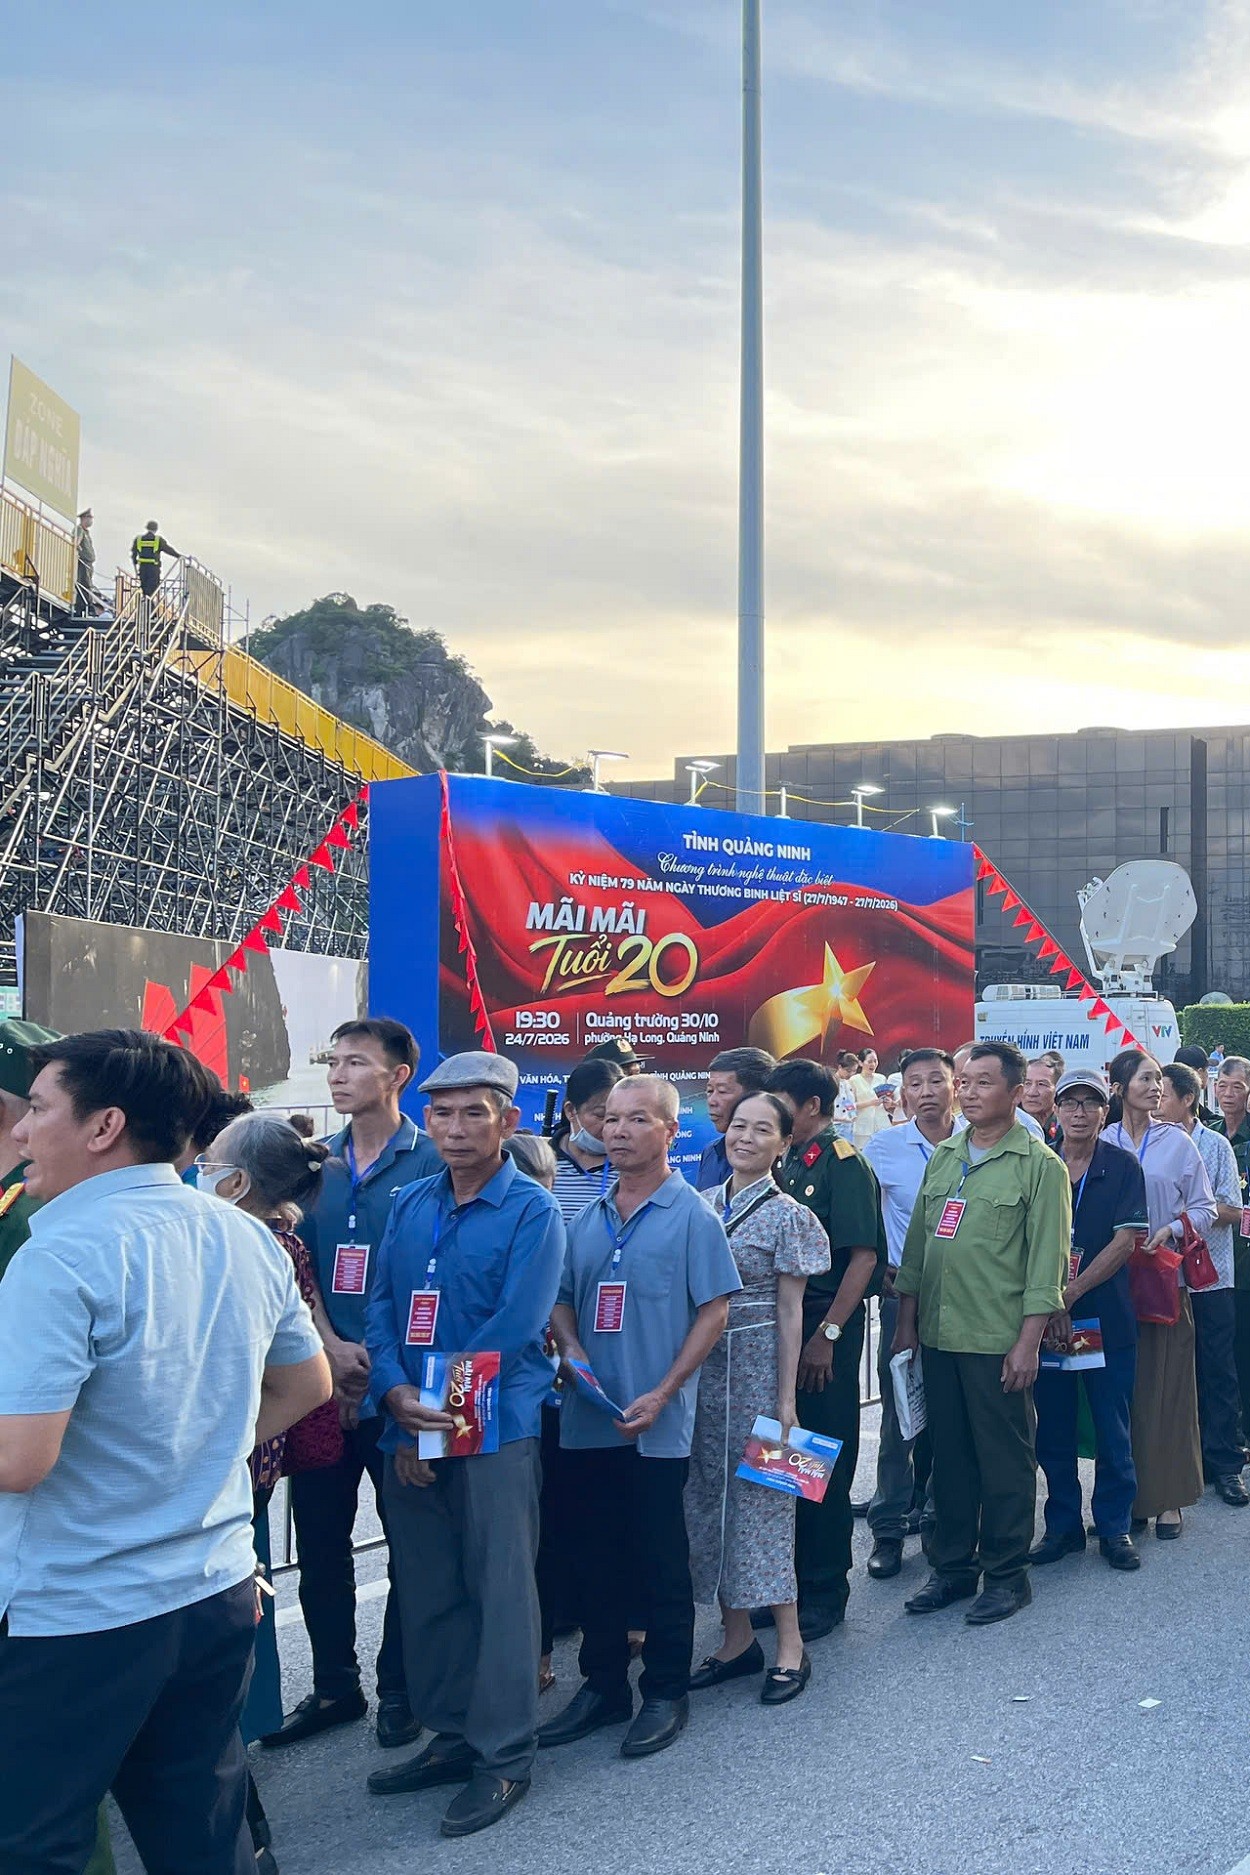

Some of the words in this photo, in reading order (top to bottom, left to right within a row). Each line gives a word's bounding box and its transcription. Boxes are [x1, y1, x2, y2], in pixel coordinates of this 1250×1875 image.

[683, 830, 719, 852] TỈNH
[722, 836, 774, 857] QUẢNG
[777, 844, 811, 861] NINH
[657, 851, 708, 882] Chương
[708, 859, 736, 878] trình
[738, 863, 764, 885] nghệ
[766, 865, 794, 886] thuật
[795, 868, 814, 887] đặc
[814, 872, 834, 889] biệt
[588, 874, 618, 890] NIỆM
[620, 878, 634, 890] 79
[637, 877, 663, 892] NĂM
[666, 880, 694, 895] NGÀY
[697, 883, 742, 898] THƯƠNG
[744, 888, 768, 900] BINH
[770, 887, 791, 904] LIỆT
[792, 888, 802, 903] SĨ
[803, 892, 848, 907] (27/7/1947
[854, 896, 898, 912] 27/7/2026)
[525, 896, 586, 932] MÃI
[589, 901, 646, 934] MÃI
[528, 934, 613, 994] Tuổi
[604, 932, 698, 997] 20
[515, 1011, 561, 1029] 19:30
[585, 1012, 633, 1031] Quảng
[634, 1012, 679, 1031] trường
[681, 1013, 719, 1029] 30/10
[505, 1033, 570, 1046] 24/7/2026
[640, 1033, 666, 1045] Long,
[667, 1031, 697, 1045] Quảng
[699, 1032, 719, 1043] Ninh
[1152, 1025, 1173, 1038] VTV
[1066, 1033, 1090, 1050] NAM
[519, 1073, 539, 1085] VĂN
[669, 1070, 697, 1081] QUẢNG
[697, 1071, 710, 1080] NIN
[449, 1381, 465, 1407] 20
